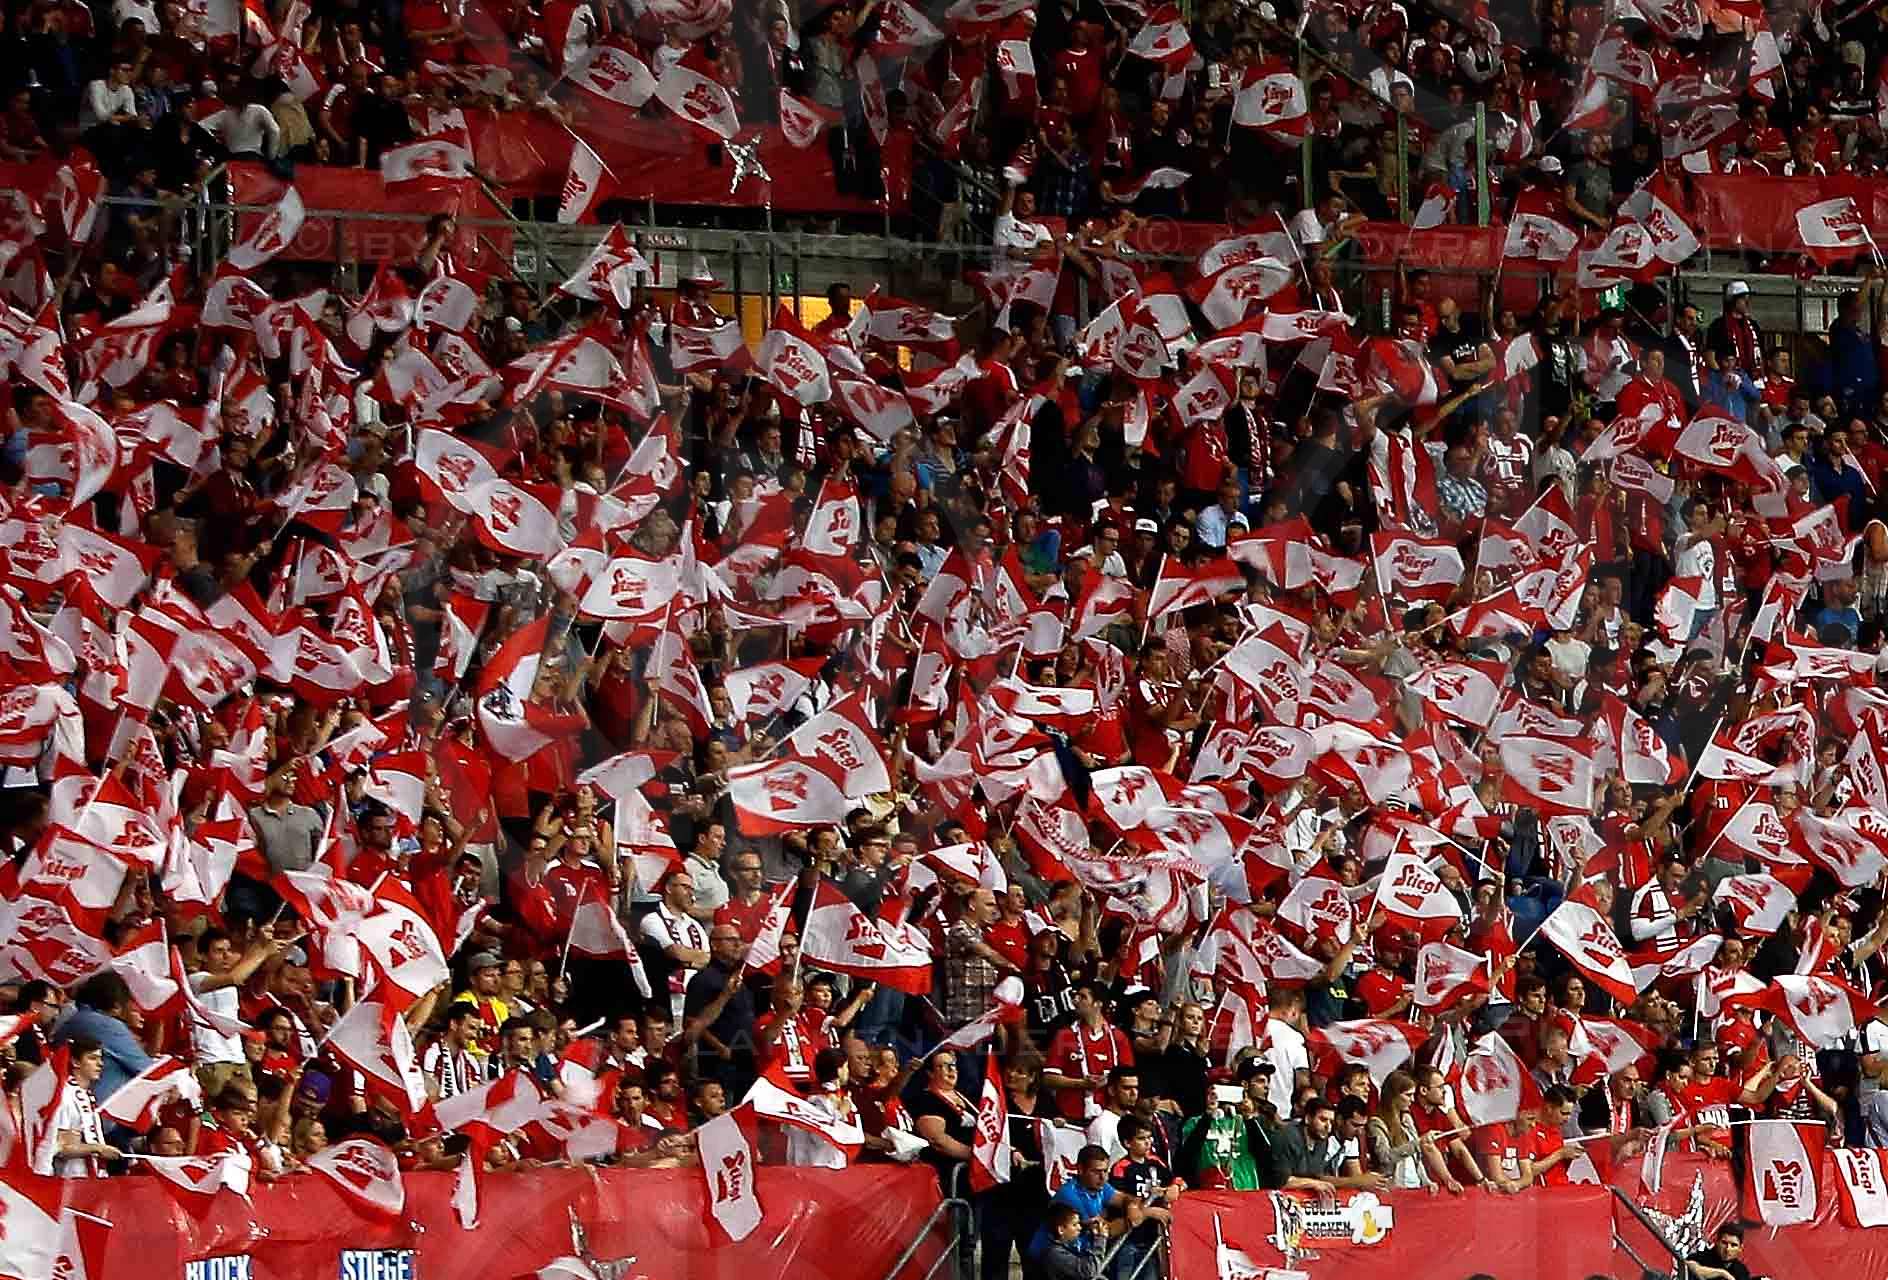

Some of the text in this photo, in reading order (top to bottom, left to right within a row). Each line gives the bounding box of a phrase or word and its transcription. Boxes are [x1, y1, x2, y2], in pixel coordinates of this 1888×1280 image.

[780, 345, 819, 380] Stiegl
[1392, 544, 1435, 567] Stiegl
[819, 728, 862, 769] Stiegl
[1246, 726, 1292, 757] Stiegl
[1395, 865, 1439, 896] Stiegl
[722, 1150, 745, 1202] Stiegl
[1773, 1160, 1801, 1208] Stiegl
